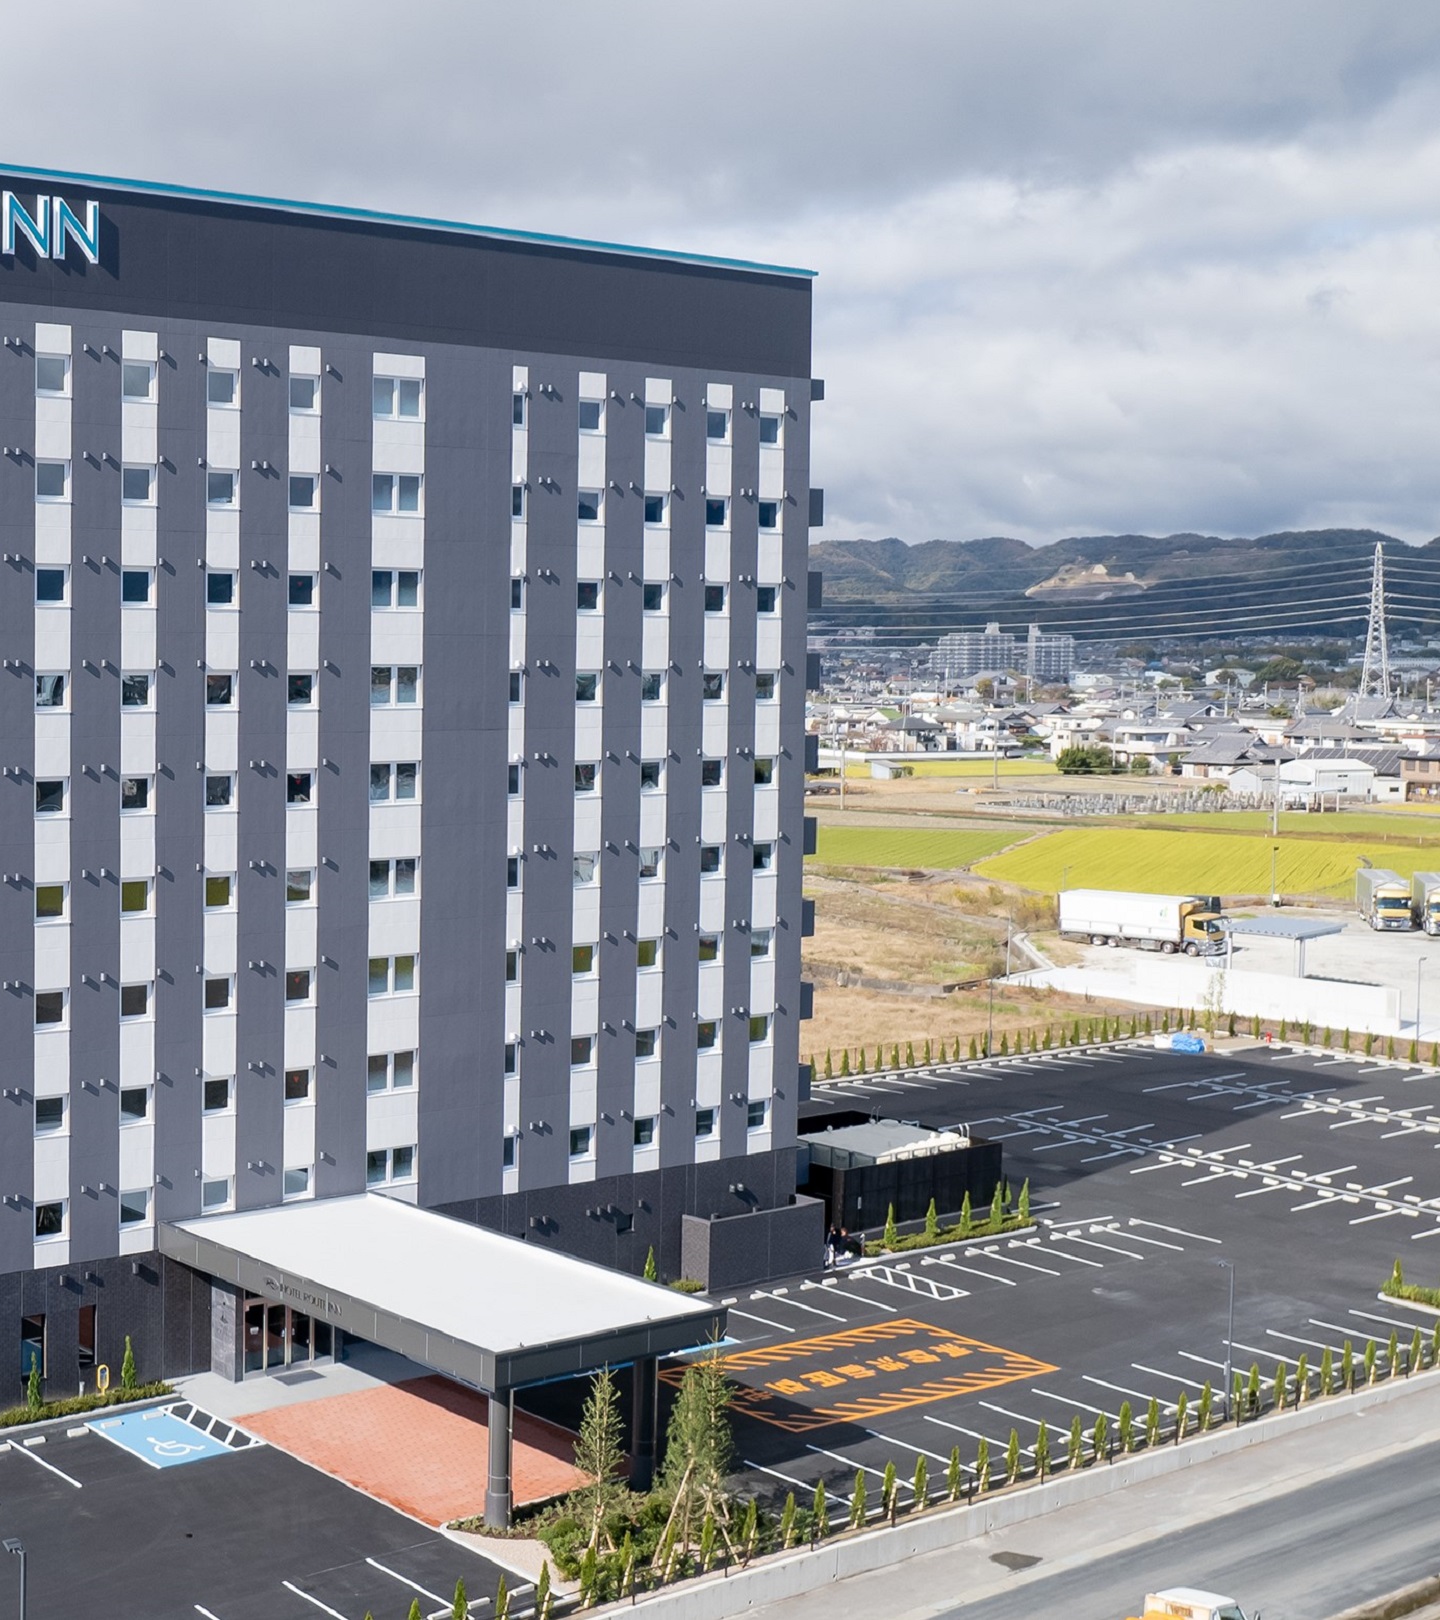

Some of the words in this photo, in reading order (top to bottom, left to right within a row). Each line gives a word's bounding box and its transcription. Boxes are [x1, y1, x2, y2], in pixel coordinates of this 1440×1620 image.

[280, 1283, 302, 1301] HOTEL
[733, 1342, 973, 1402] 消防活動用空地
